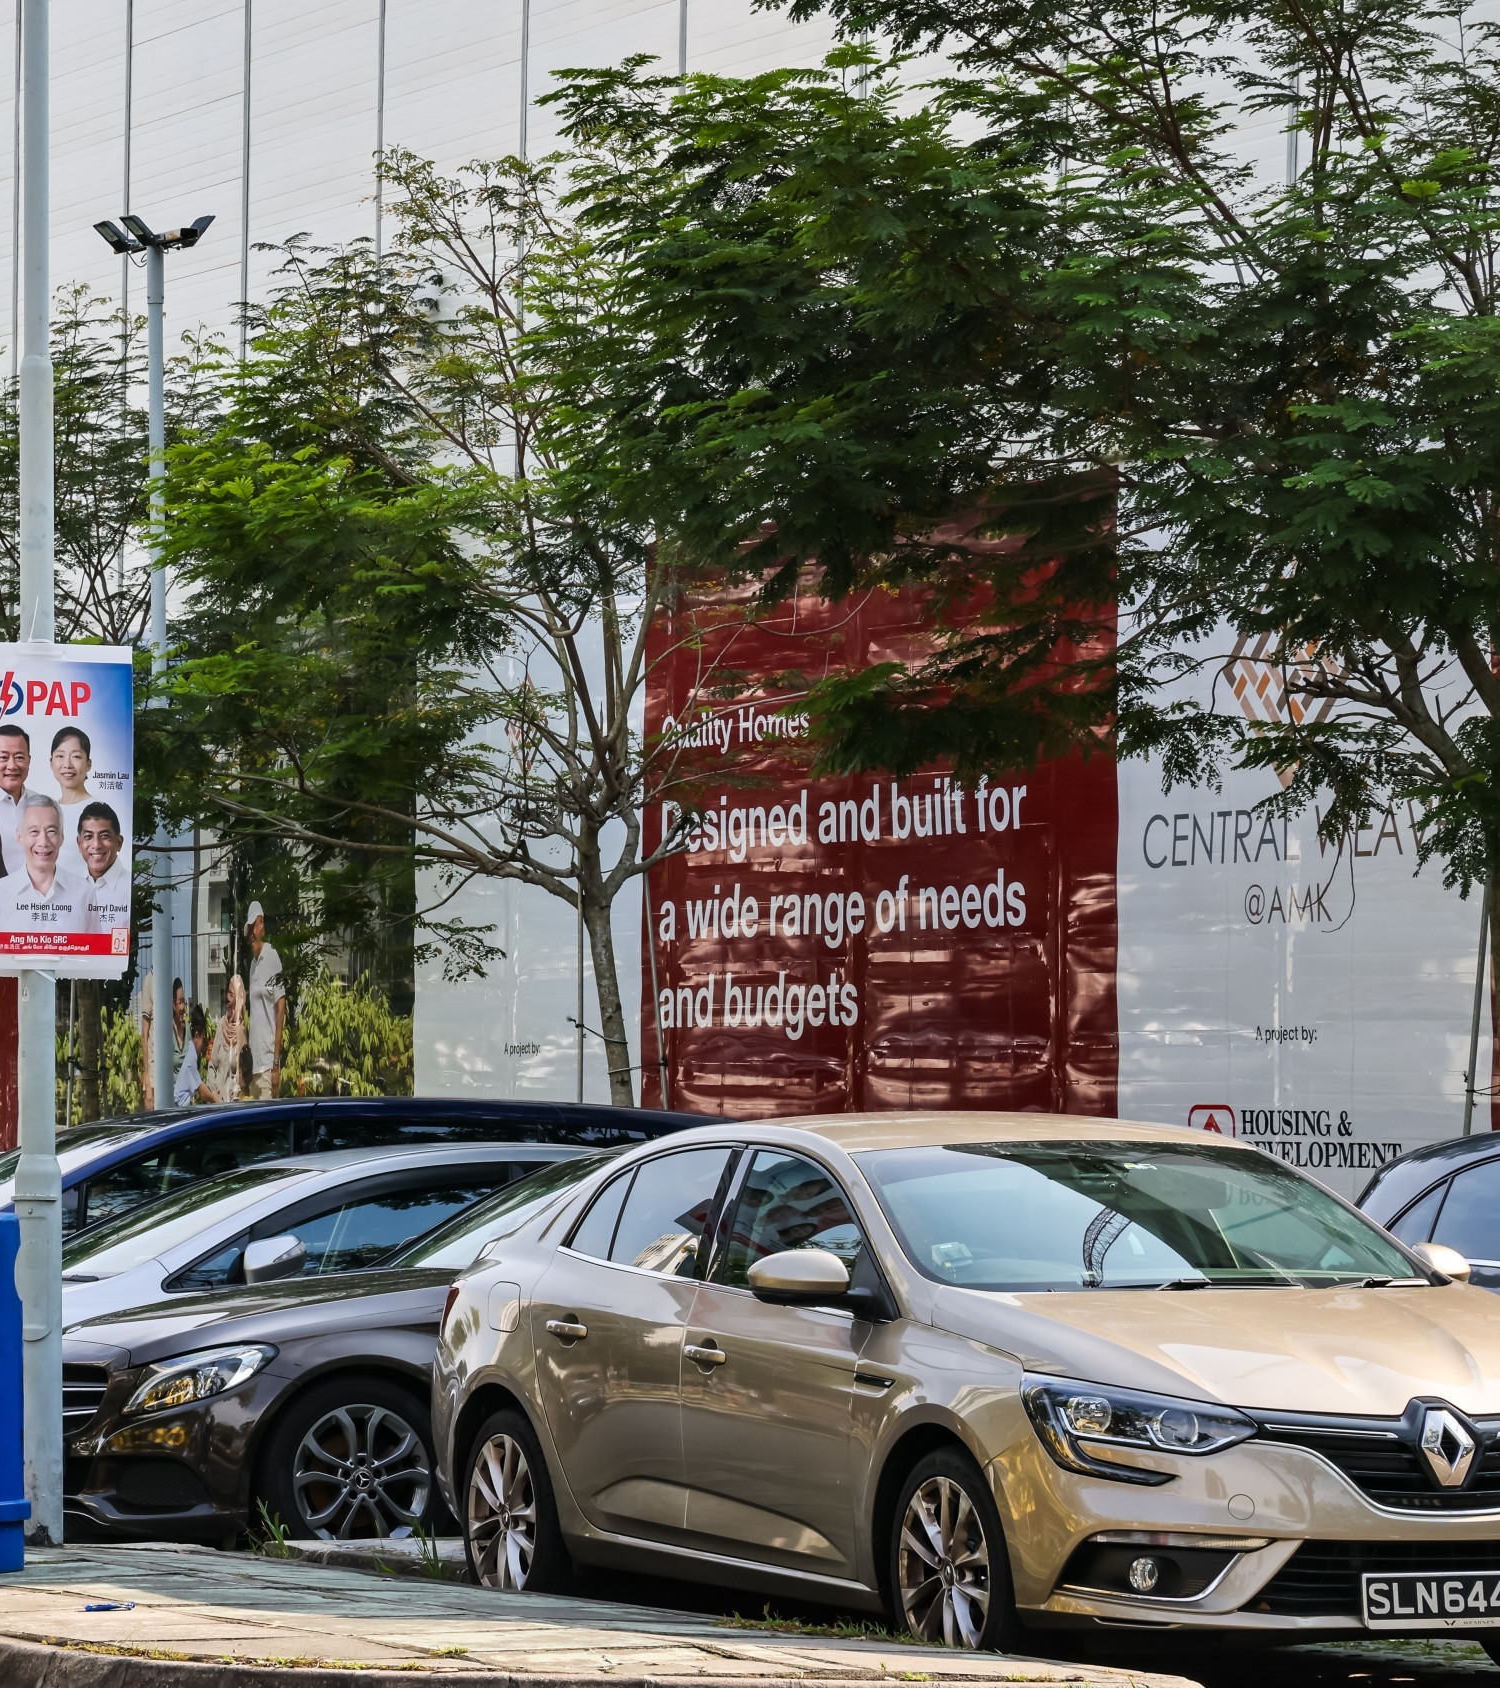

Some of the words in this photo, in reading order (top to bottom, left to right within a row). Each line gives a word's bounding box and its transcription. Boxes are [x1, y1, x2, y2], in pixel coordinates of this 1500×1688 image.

[26, 680, 92, 717] PAP
[661, 710, 733, 755] Quality
[738, 706, 810, 743] Homes
[92, 771, 116, 780] Jasmin
[117, 772, 129, 780] Lau
[661, 789, 808, 863] Designed
[818, 784, 880, 844] and
[891, 777, 966, 841] built
[974, 774, 1027, 832] for
[1142, 810, 1300, 870] CENTRAL
[1315, 795, 1456, 859] WEAV
[16, 903, 29, 911] Lee
[30, 903, 51, 911] Hsien
[51, 903, 72, 913] Loong
[87, 904, 108, 913] Darryl
[109, 904, 128, 913] David
[658, 900, 676, 941] a
[685, 883, 759, 940] wide
[768, 891, 866, 949] range
[875, 874, 911, 933] of
[918, 867, 1027, 929] needs
[1244, 883, 1333, 925] @AMK
[9, 935, 26, 944] Ang
[26, 935, 39, 944] Mo
[40, 935, 52, 944] Kio
[53, 935, 68, 944] GRC
[658, 973, 714, 1029] and
[723, 970, 859, 1040] budgets
[504, 1042, 509, 1055] A
[510, 1042, 531, 1058] project
[532, 1041, 541, 1056] by:
[1256, 1025, 1263, 1041] A
[1265, 1025, 1299, 1045] project
[1301, 1025, 1318, 1045] by:
[1240, 1109, 1333, 1137] HOUSING
[1337, 1110, 1354, 1138] &
[1244, 1141, 1403, 1169] VELOPMENT
